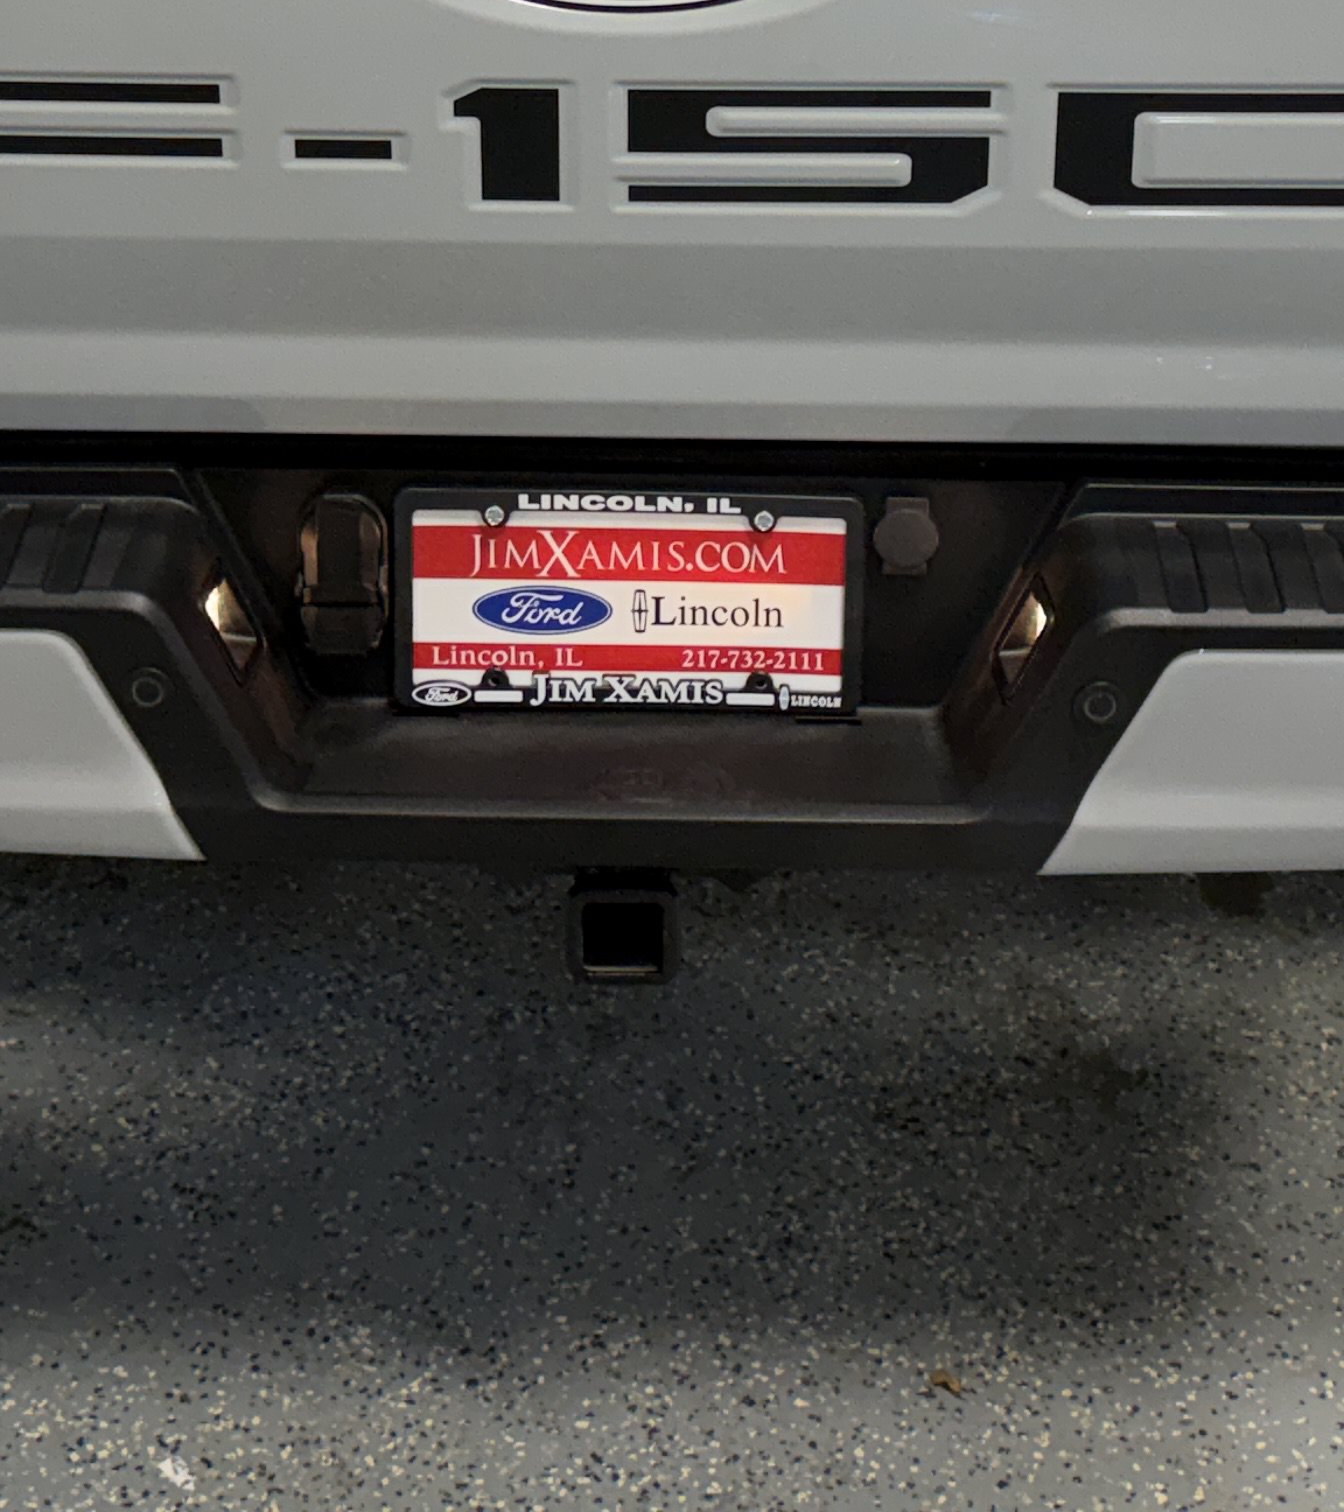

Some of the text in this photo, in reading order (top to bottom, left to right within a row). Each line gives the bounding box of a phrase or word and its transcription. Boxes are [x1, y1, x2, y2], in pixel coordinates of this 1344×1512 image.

[517, 493, 741, 514] LINCOLN, IL
[470, 529, 788, 578] JIMXAMIS.COM
[501, 592, 584, 626] Ford
[651, 595, 784, 628] Lincoln
[432, 645, 583, 668] Lincoln, IL
[682, 649, 824, 671] 217-732-2111
[530, 674, 724, 707] JIM XAMIS
[790, 694, 842, 708] LINCOLN
